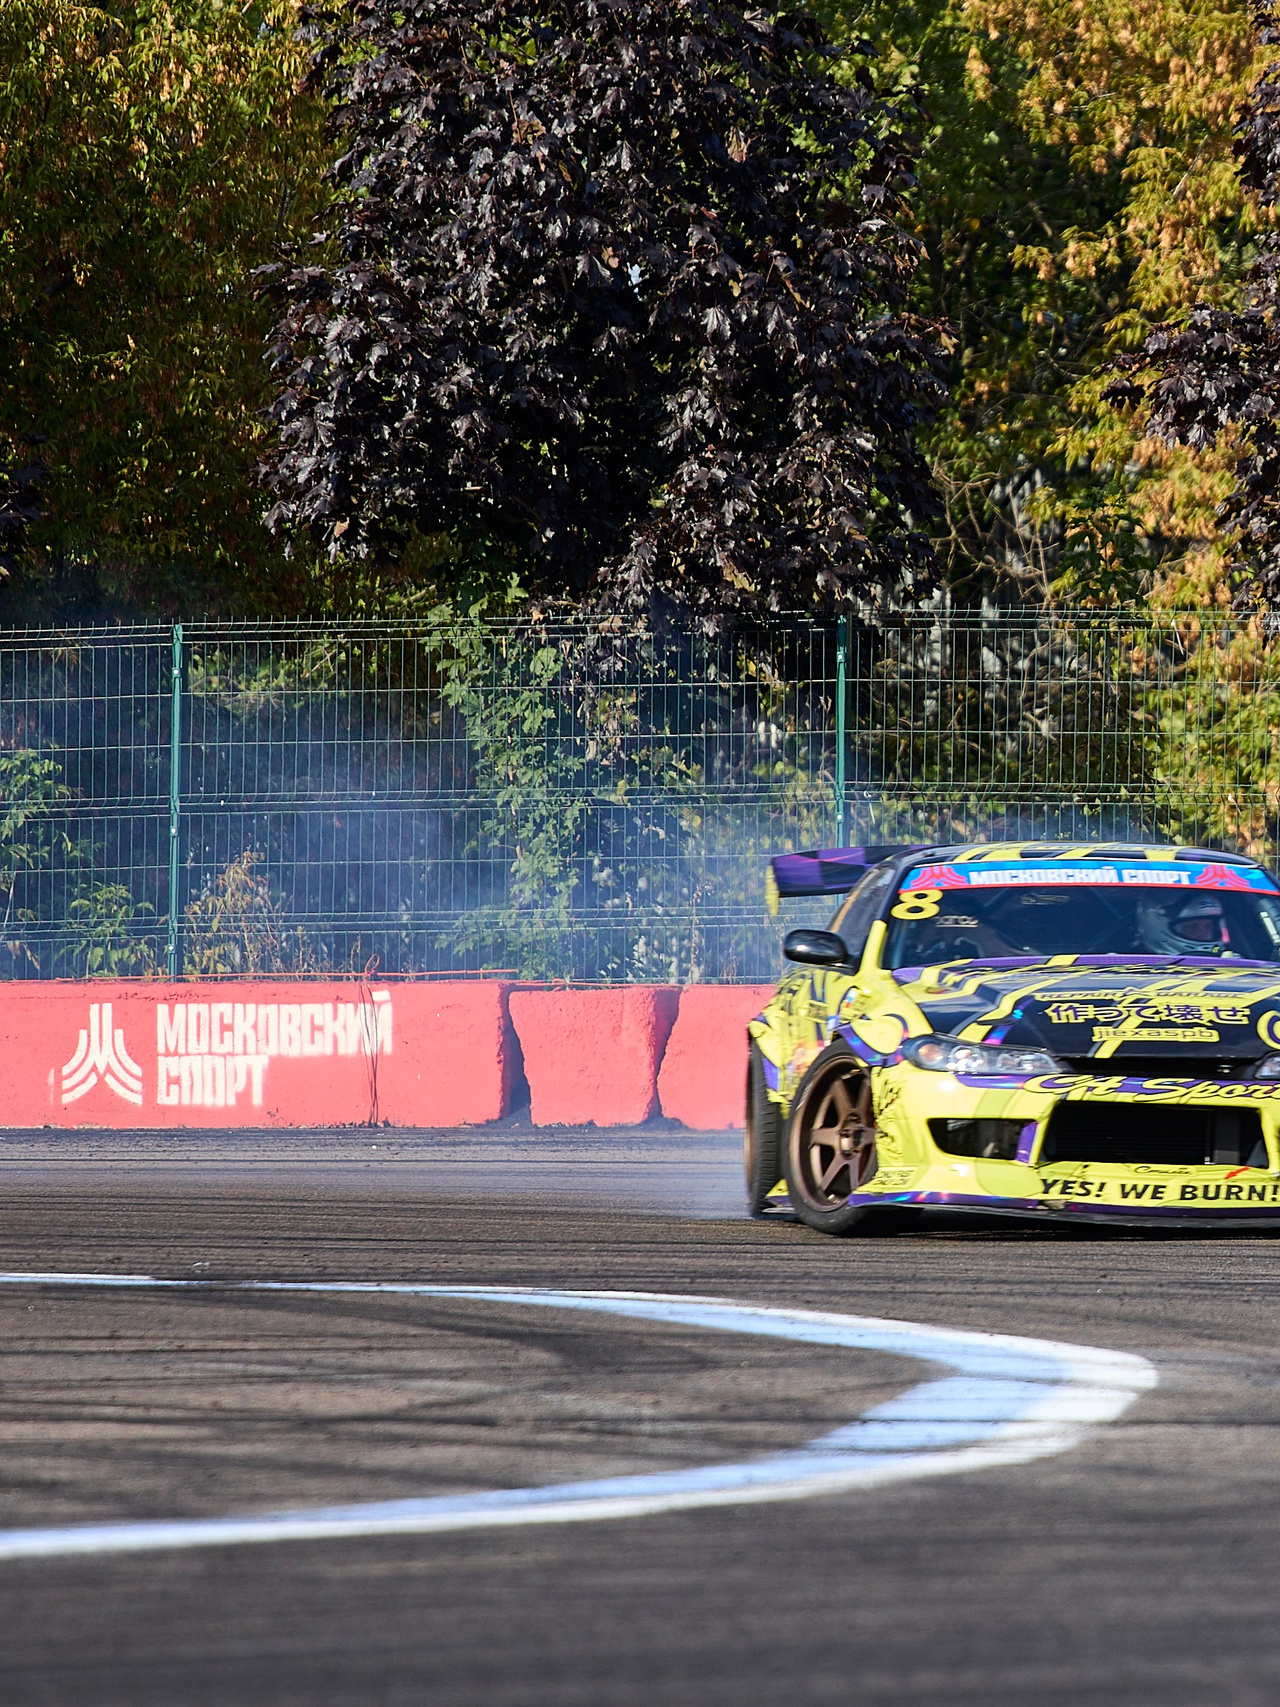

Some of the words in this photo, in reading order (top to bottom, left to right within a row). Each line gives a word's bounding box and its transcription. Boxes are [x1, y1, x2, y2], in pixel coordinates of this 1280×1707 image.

[968, 866, 1118, 886] МОСКОВСКИЙ
[1121, 868, 1191, 885] СПОРТ
[891, 889, 943, 920] 8
[1040, 991, 1118, 999] REPAIR
[1155, 991, 1246, 999] GARAGE
[156, 990, 393, 1056] МОСКОВСКИЙ
[1047, 1003, 1249, 1024] 作って壊せ
[156, 1054, 269, 1107] СПОРТ
[1040, 1178, 1105, 1197] YES!
[1119, 1184, 1167, 1201] WE
[1178, 1184, 1280, 1202] BURN!
